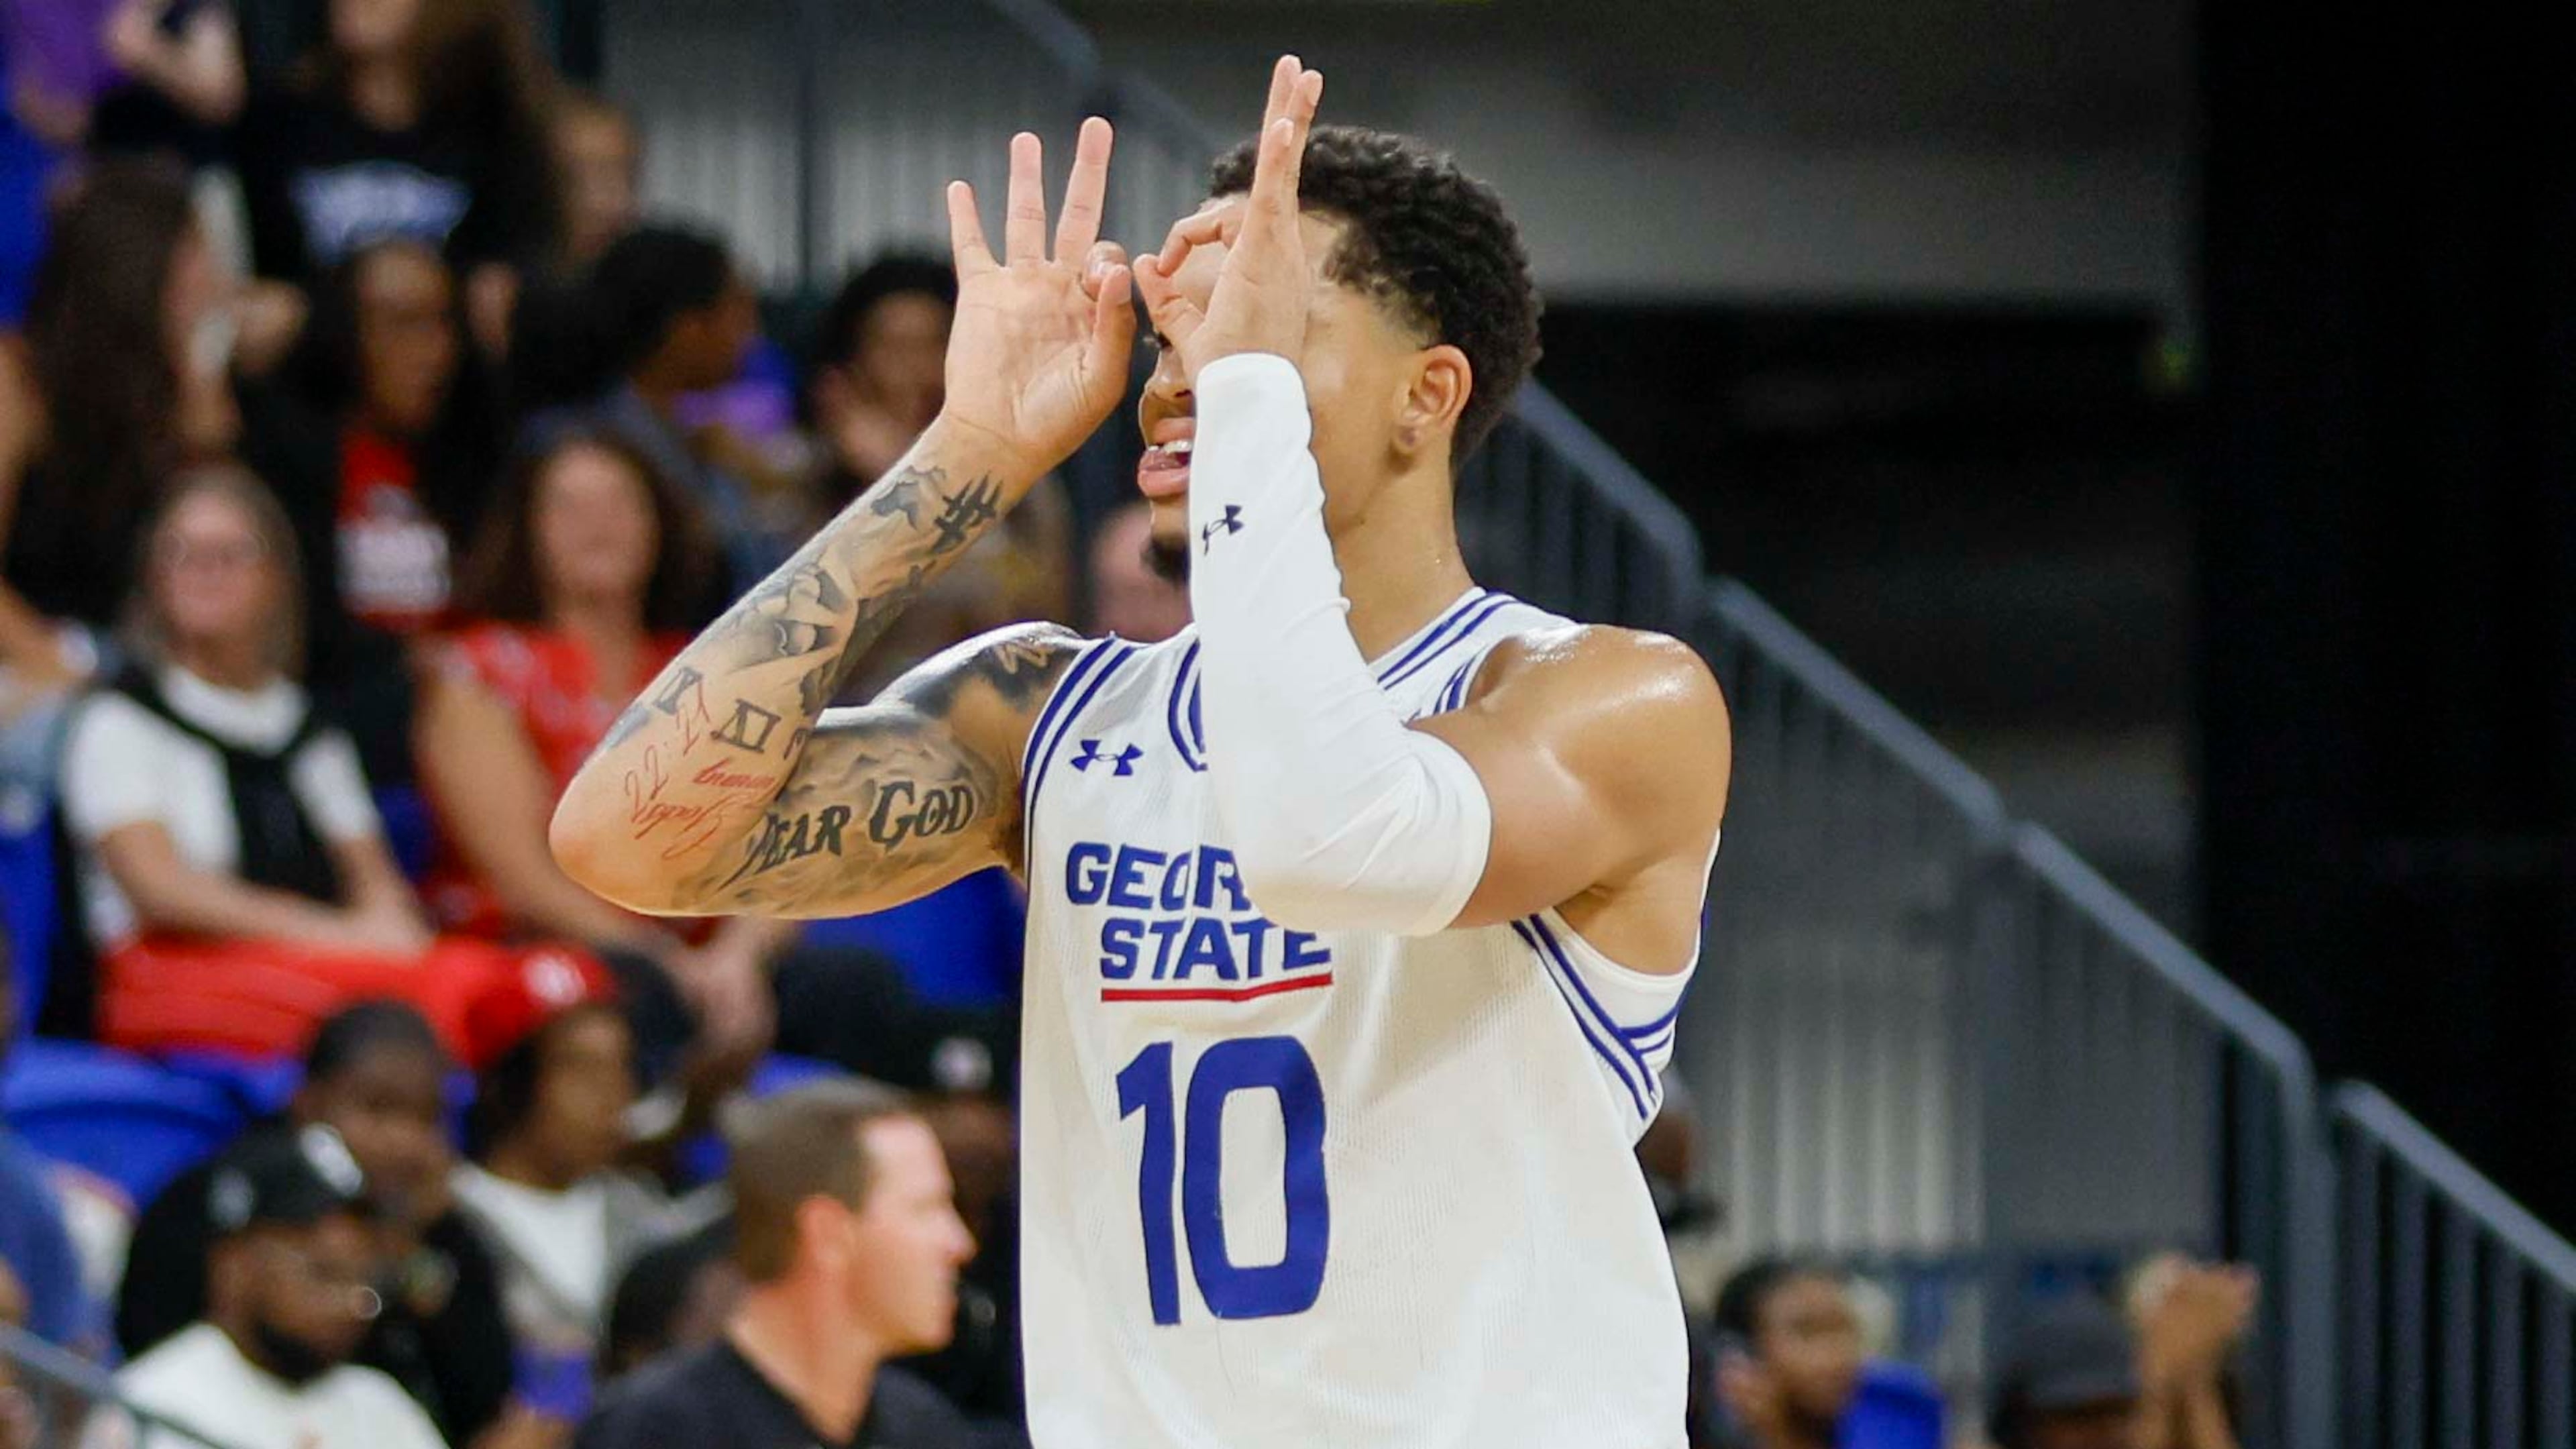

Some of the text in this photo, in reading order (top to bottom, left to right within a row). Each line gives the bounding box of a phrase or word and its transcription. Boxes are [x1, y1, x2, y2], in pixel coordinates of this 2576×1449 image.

[869, 780, 974, 853] GOD
[1065, 841, 1252, 912] GEOR
[1100, 916, 1332, 981] STATE
[1116, 1035, 1330, 1326] 10
